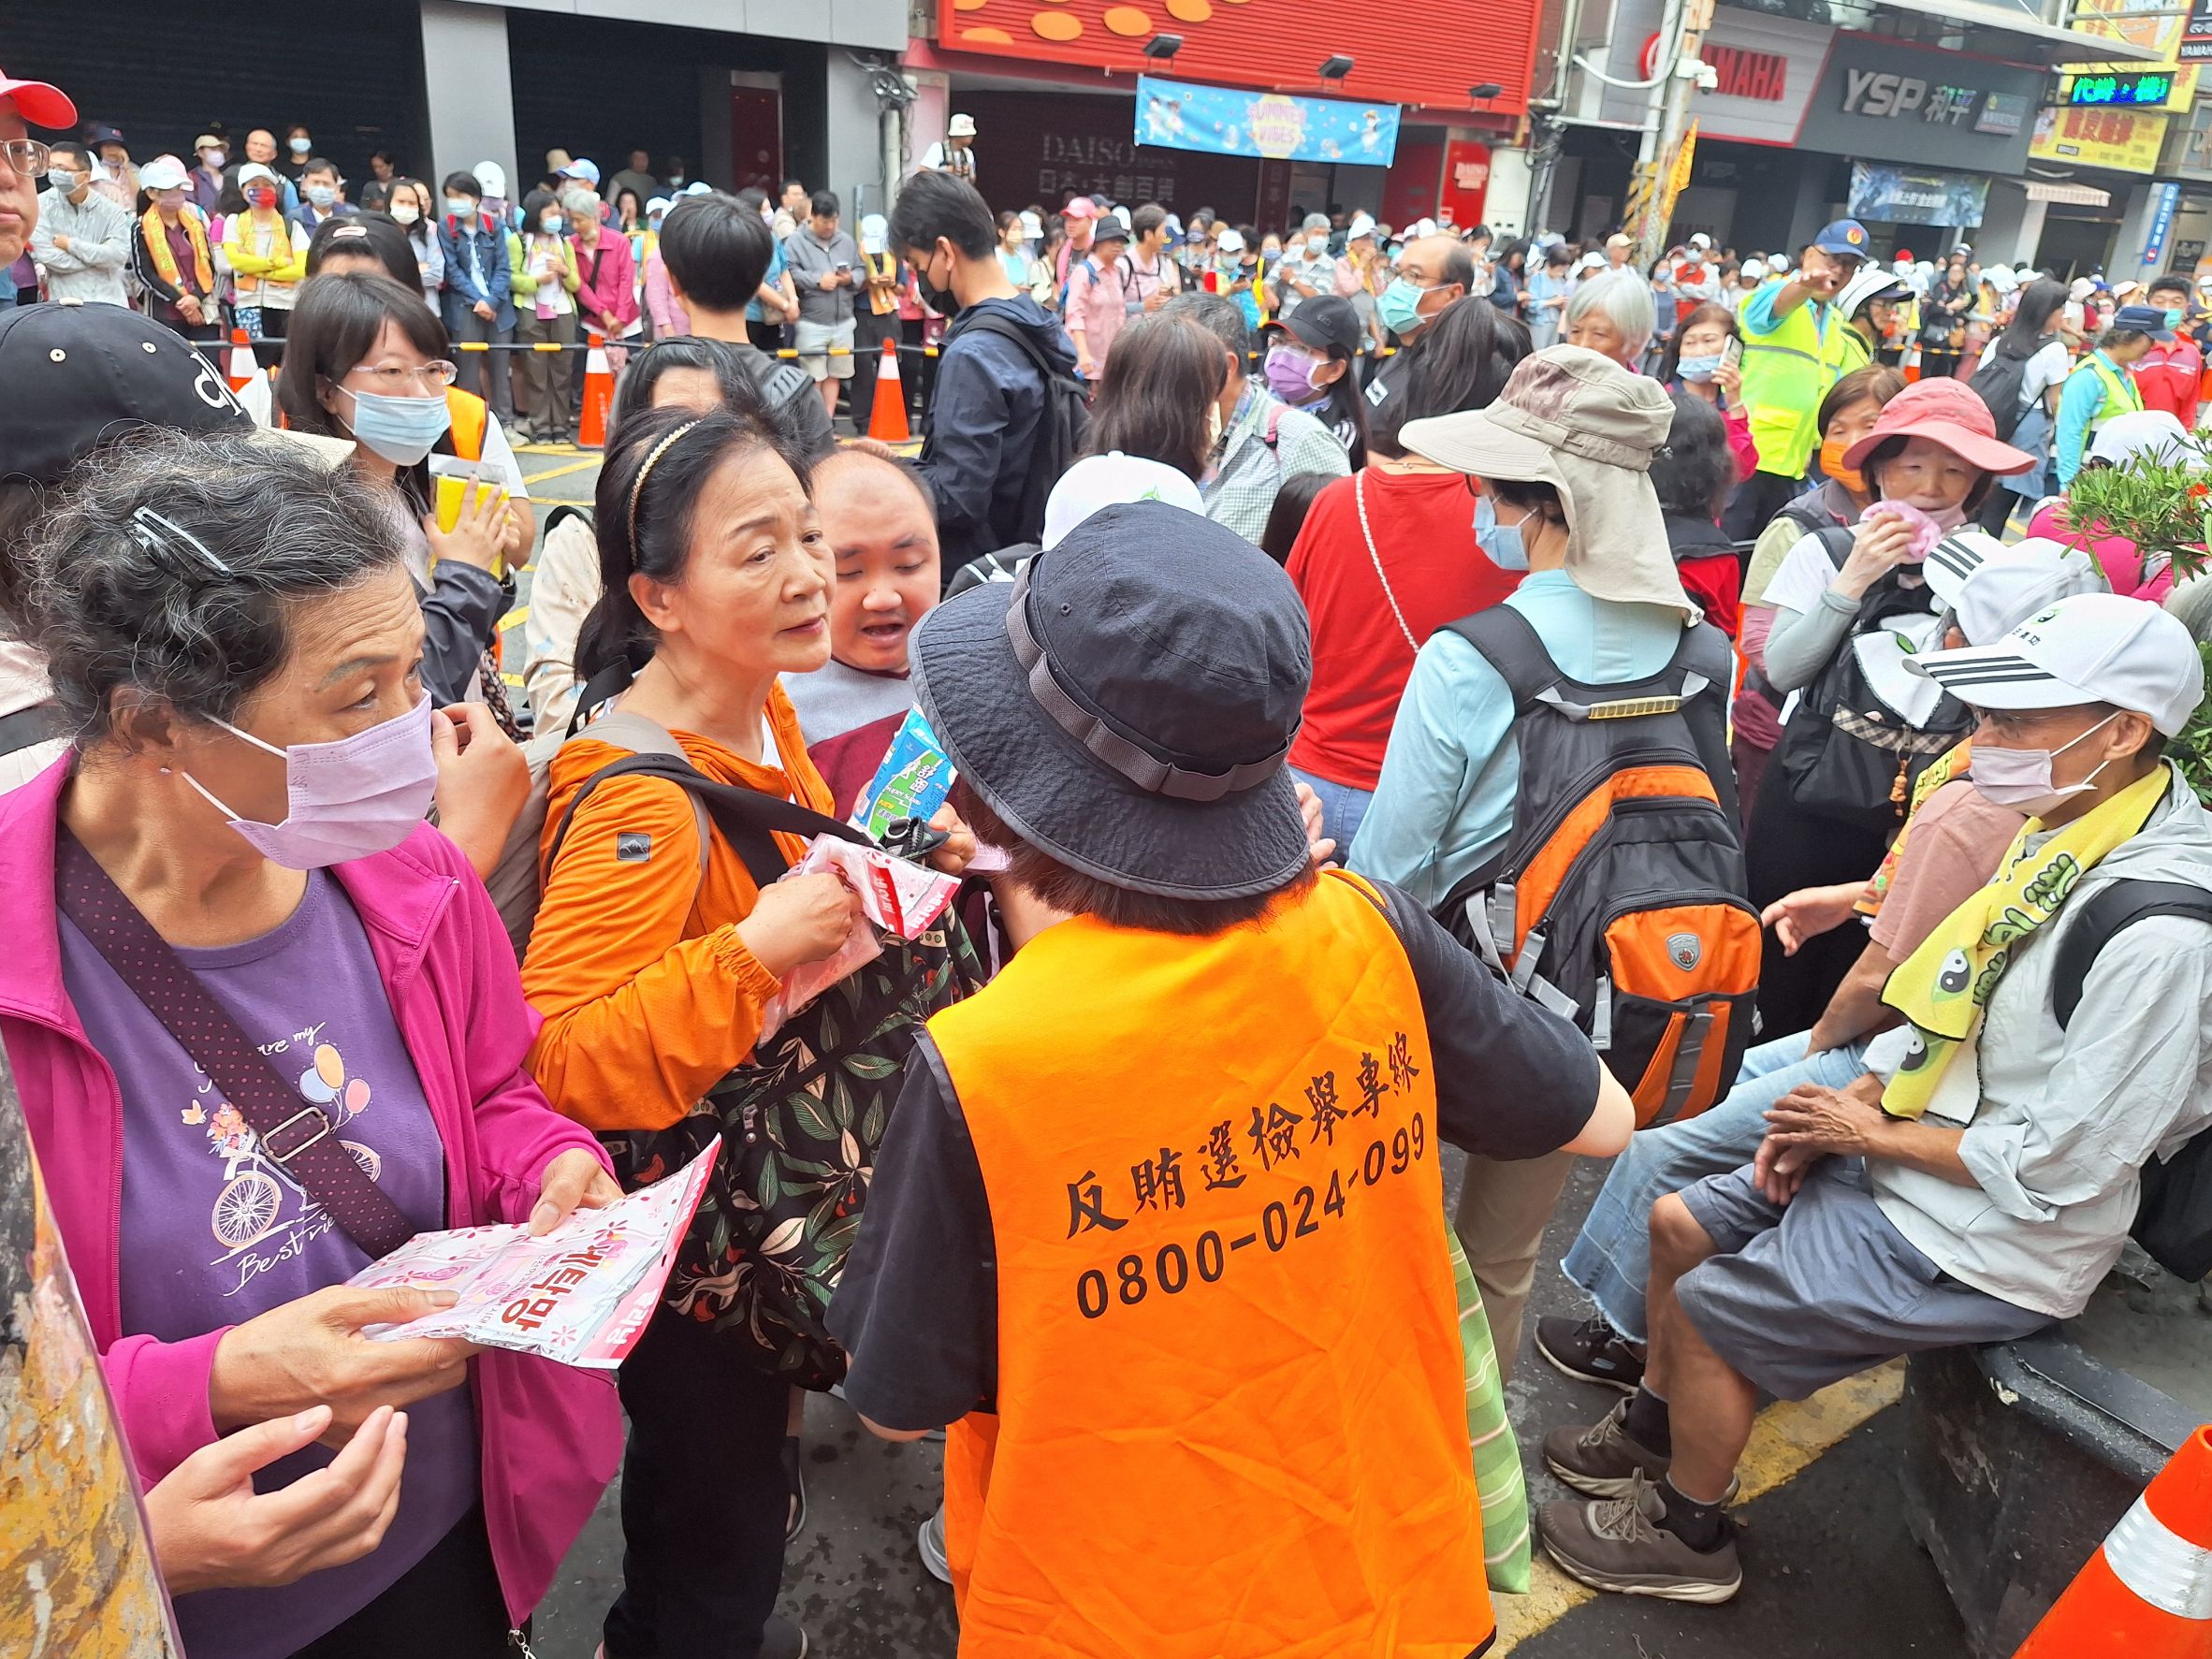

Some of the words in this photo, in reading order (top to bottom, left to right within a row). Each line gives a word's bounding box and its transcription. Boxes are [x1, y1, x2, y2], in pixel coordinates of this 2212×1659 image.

[1695, 44, 1788, 101] AMAHA
[1842, 67, 1928, 118] YSP
[1042, 134, 1136, 167] DAISO
[292, 1021, 327, 1047] my
[1066, 1031, 1419, 1240] 反賄選檢舉專線
[1076, 1112, 1424, 1319] 0800-024-099
[222, 1230, 303, 1297] Best
[502, 1244, 611, 1332] 세탁망
